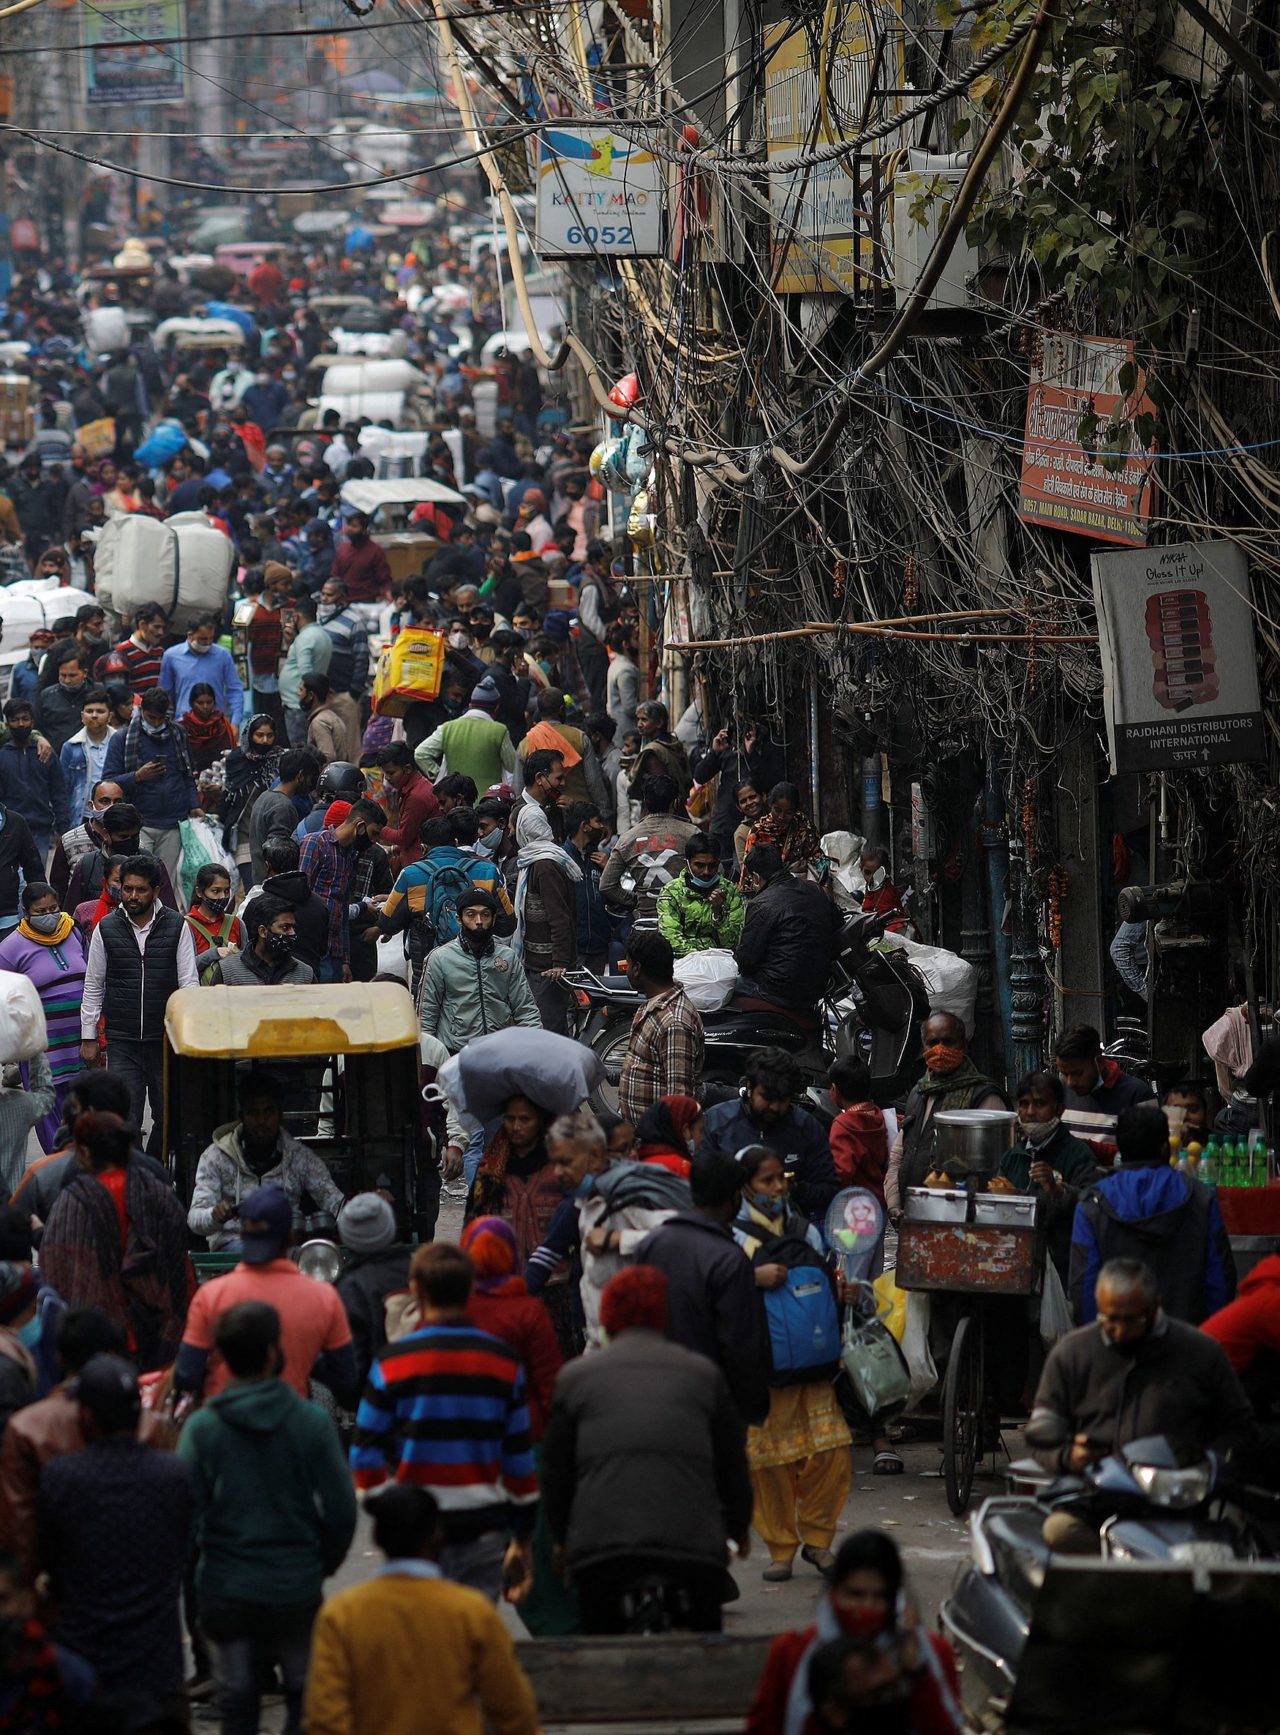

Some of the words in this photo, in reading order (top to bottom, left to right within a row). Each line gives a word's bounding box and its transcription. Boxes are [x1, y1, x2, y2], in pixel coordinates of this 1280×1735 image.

[552, 192, 605, 206] KATTY
[611, 193, 648, 206] MAO
[567, 226, 632, 245] 6052
[1023, 498, 1038, 516] 6057,
[1039, 500, 1054, 518] MAIN
[1070, 505, 1088, 525] SADAR
[1087, 509, 1106, 530] BAZAR,
[1160, 552, 1188, 564] NYKAA
[1145, 567, 1173, 580] Gloss
[1189, 562, 1204, 579] Up!
[1126, 725, 1177, 739] RAJDHANI
[1180, 718, 1253, 734] DISTRIBUTORS
[1150, 733, 1231, 749] INTERNATIONAL
[1172, 750, 1197, 761] ऊपर
